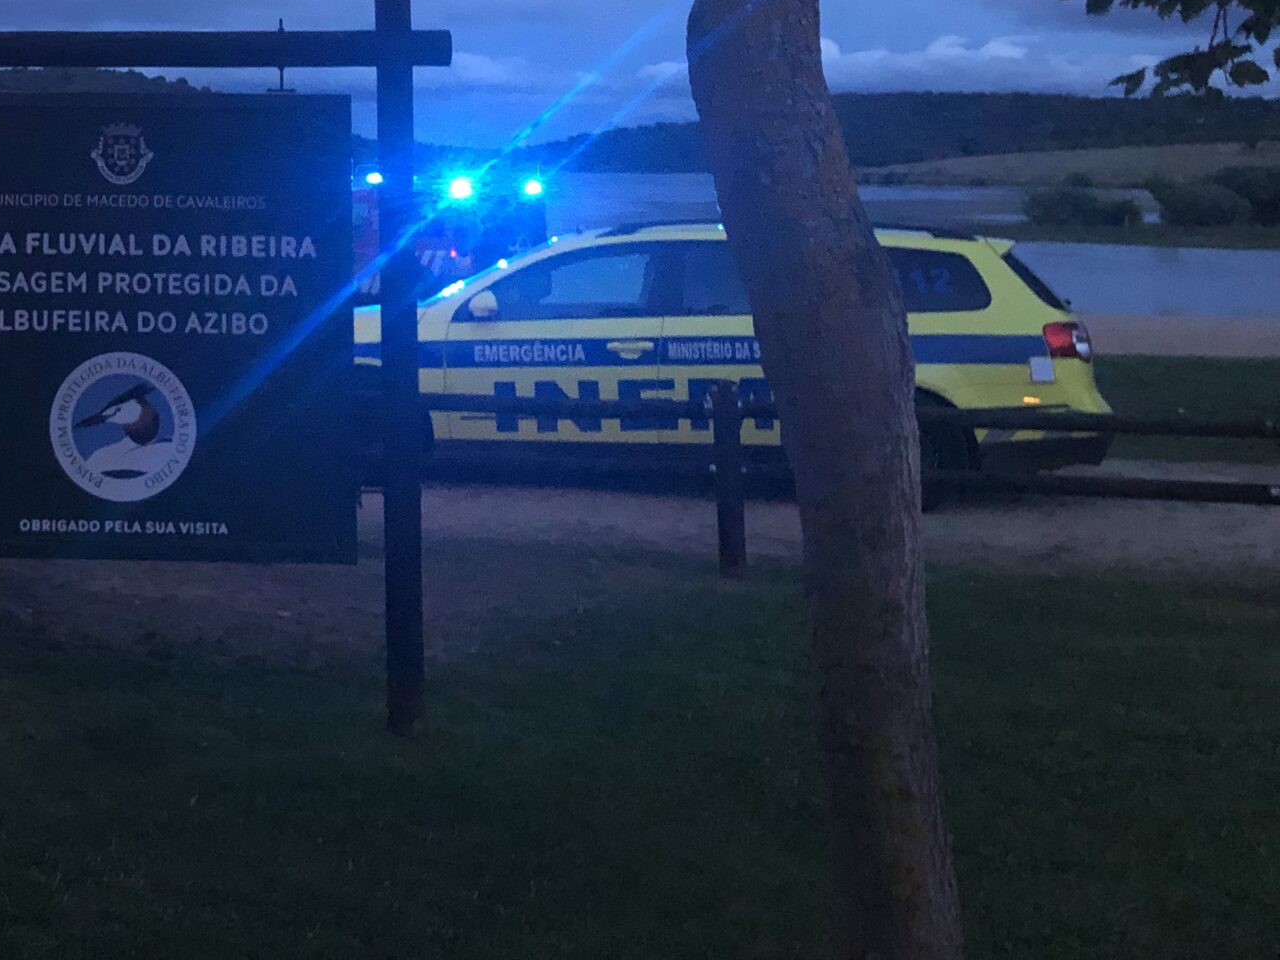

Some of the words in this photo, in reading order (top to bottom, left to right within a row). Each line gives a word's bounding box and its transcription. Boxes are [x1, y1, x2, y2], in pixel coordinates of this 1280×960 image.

[64, 194, 82, 208] DE
[87, 194, 149, 208] MACEDO
[154, 194, 173, 208] DE
[177, 194, 266, 210] CAVALEIROS
[26, 233, 143, 256] FLUVIAL
[153, 234, 191, 256] DA
[201, 234, 317, 258] RIBEIRA
[98, 272, 251, 296] PROTEGIDA
[260, 274, 298, 297] DA
[137, 311, 176, 333] DO
[185, 311, 268, 335] AZIBO
[474, 341, 585, 362] EMERGÊNCIA
[668, 339, 732, 359] MINISTÉRIO
[735, 341, 751, 359] DA
[117, 357, 136, 370] DA
[57, 359, 113, 422] PROTEGIDA
[177, 433, 190, 455] DO
[57, 427, 103, 489] PAISAGEM
[144, 459, 179, 489] AZIBO
[20, 518, 100, 533] OBRIGADO
[105, 519, 141, 533] PELA
[146, 520, 175, 534] SUA
[180, 521, 228, 535] VISITA
